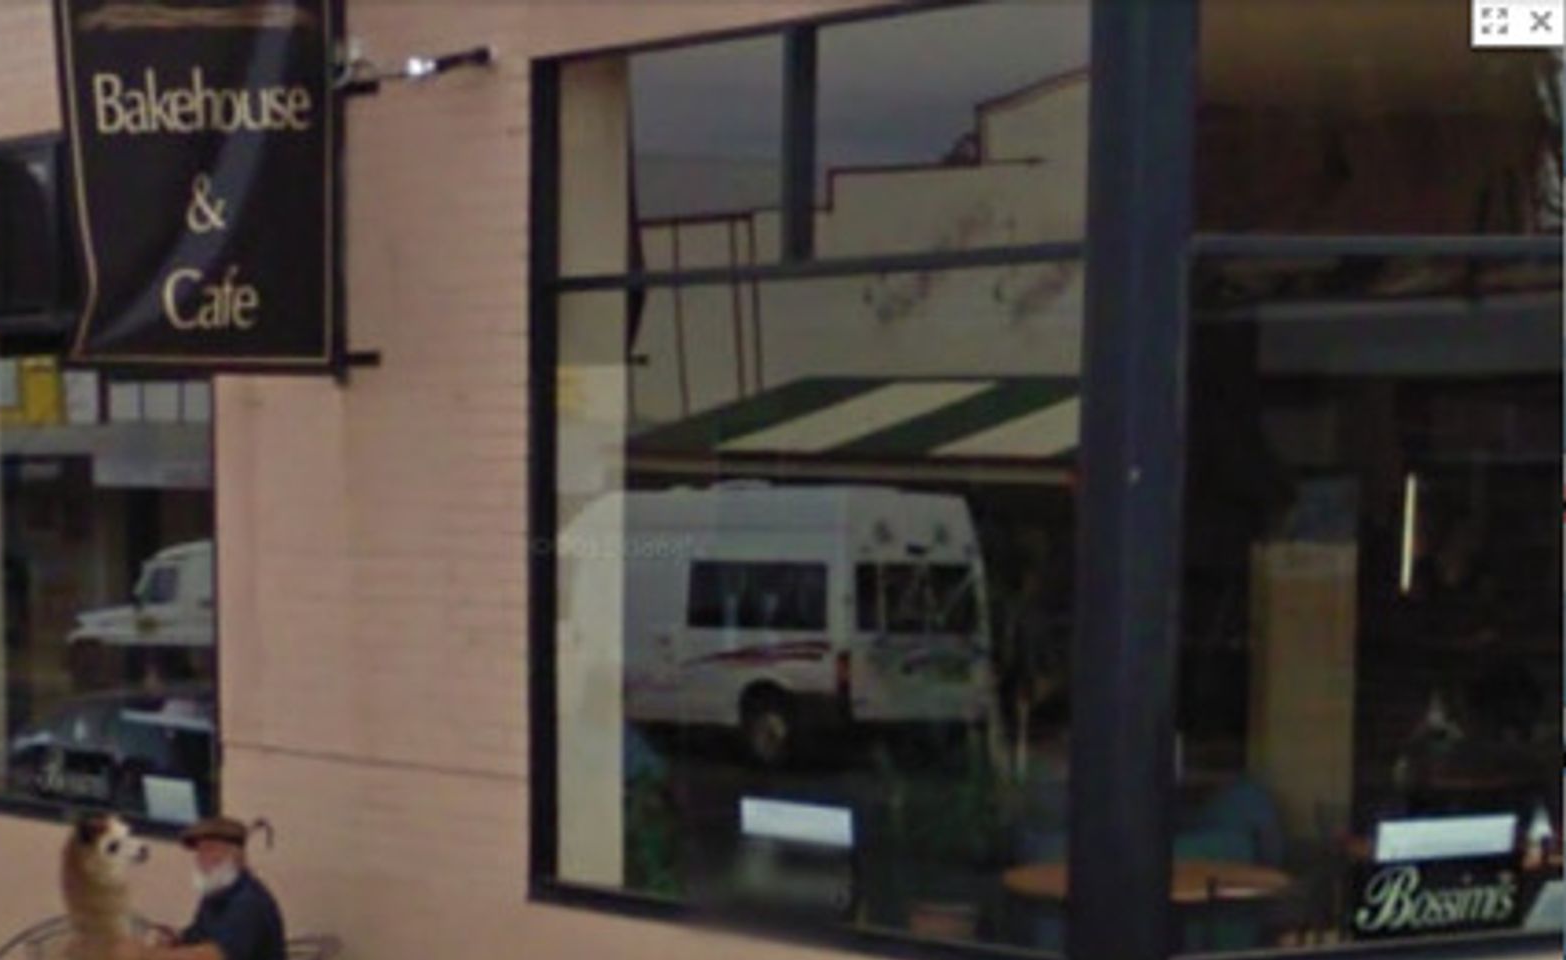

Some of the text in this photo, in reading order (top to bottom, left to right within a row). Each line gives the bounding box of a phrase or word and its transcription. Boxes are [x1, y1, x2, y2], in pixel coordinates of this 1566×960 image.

[93, 66, 313, 134] Bakehouse
[186, 174, 227, 233] &
[162, 265, 260, 330] Cafe
